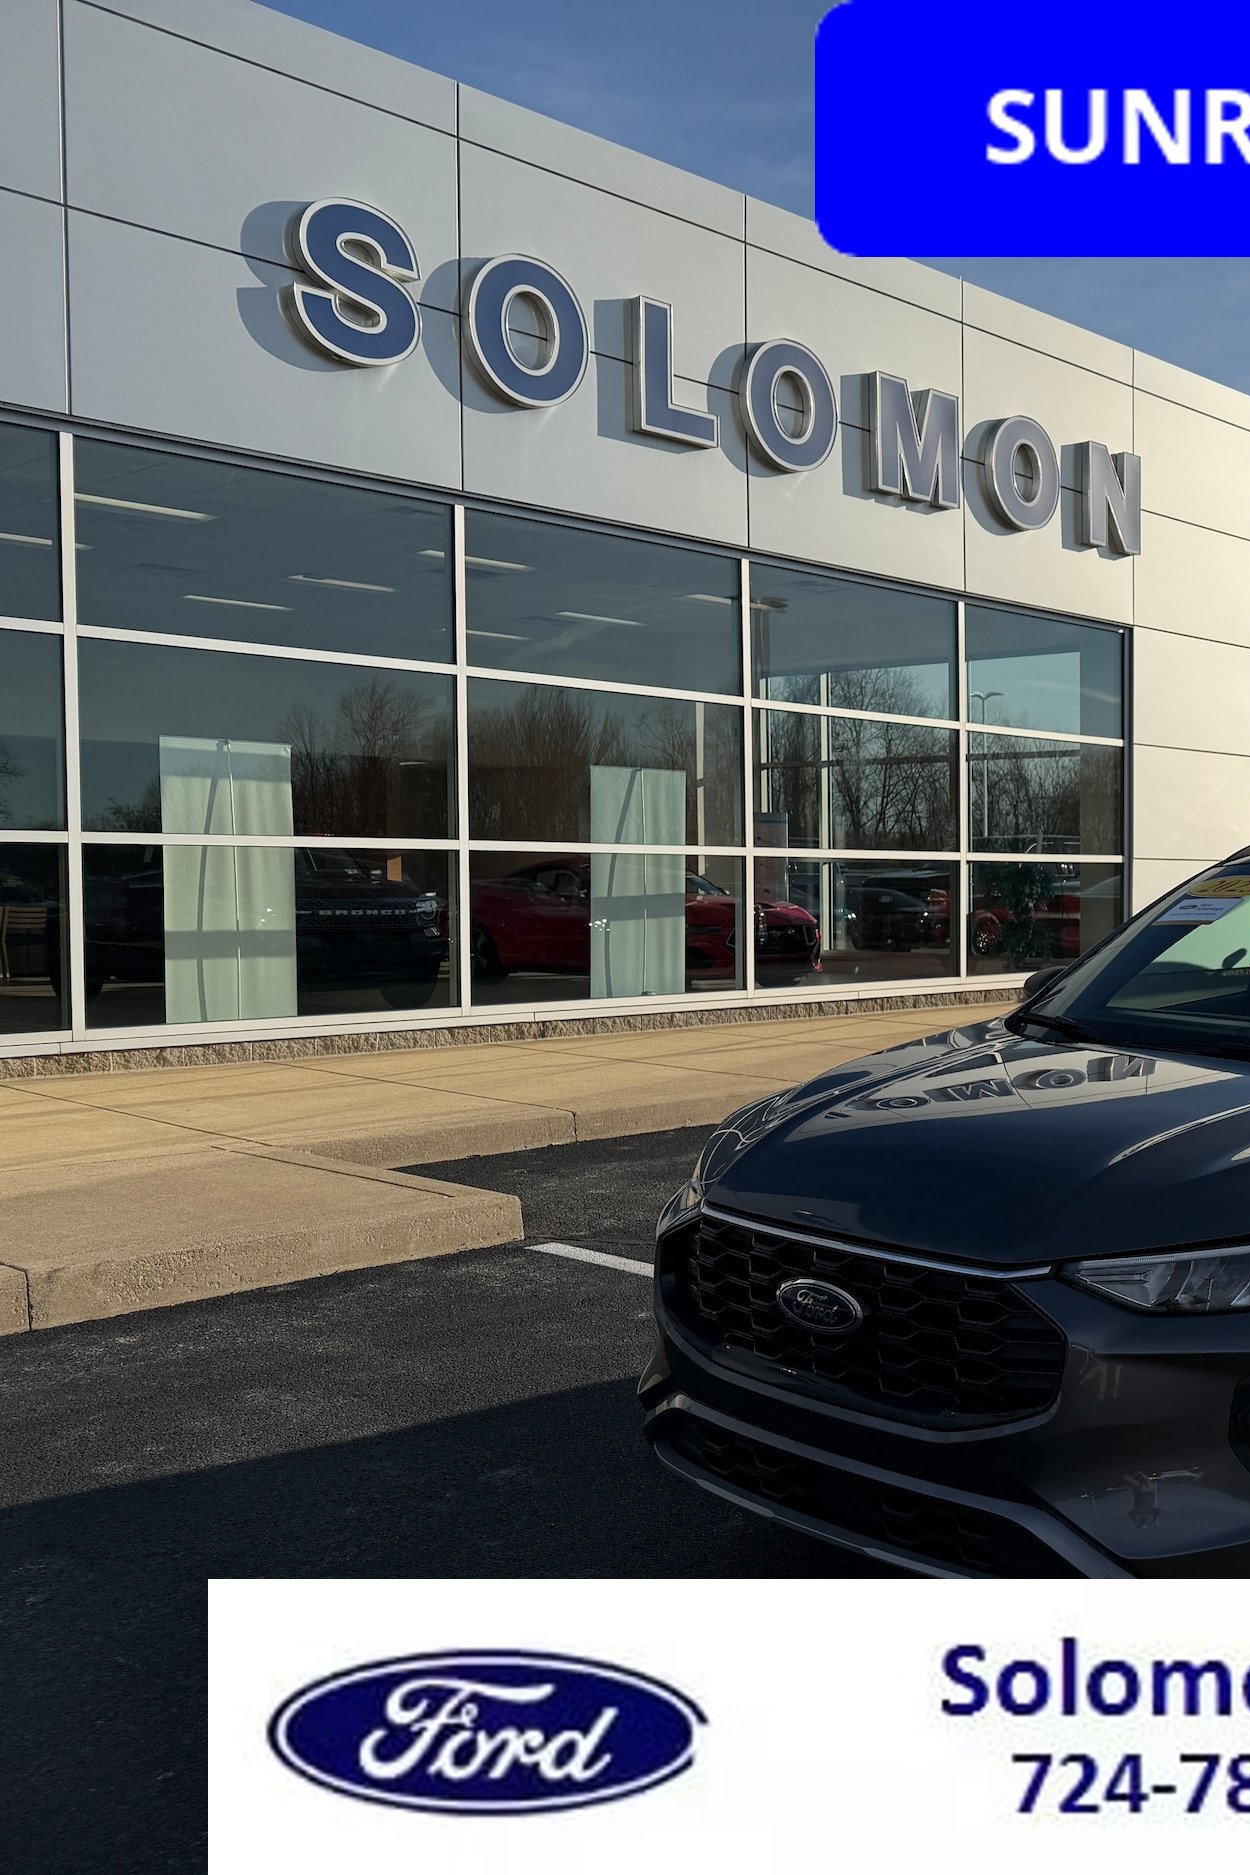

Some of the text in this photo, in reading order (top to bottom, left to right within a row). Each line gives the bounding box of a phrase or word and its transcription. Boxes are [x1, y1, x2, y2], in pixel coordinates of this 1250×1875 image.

[286, 196, 1142, 556] SOLOMON
[319, 908, 406, 916] BRONCO
[793, 1288, 838, 1324] Ford
